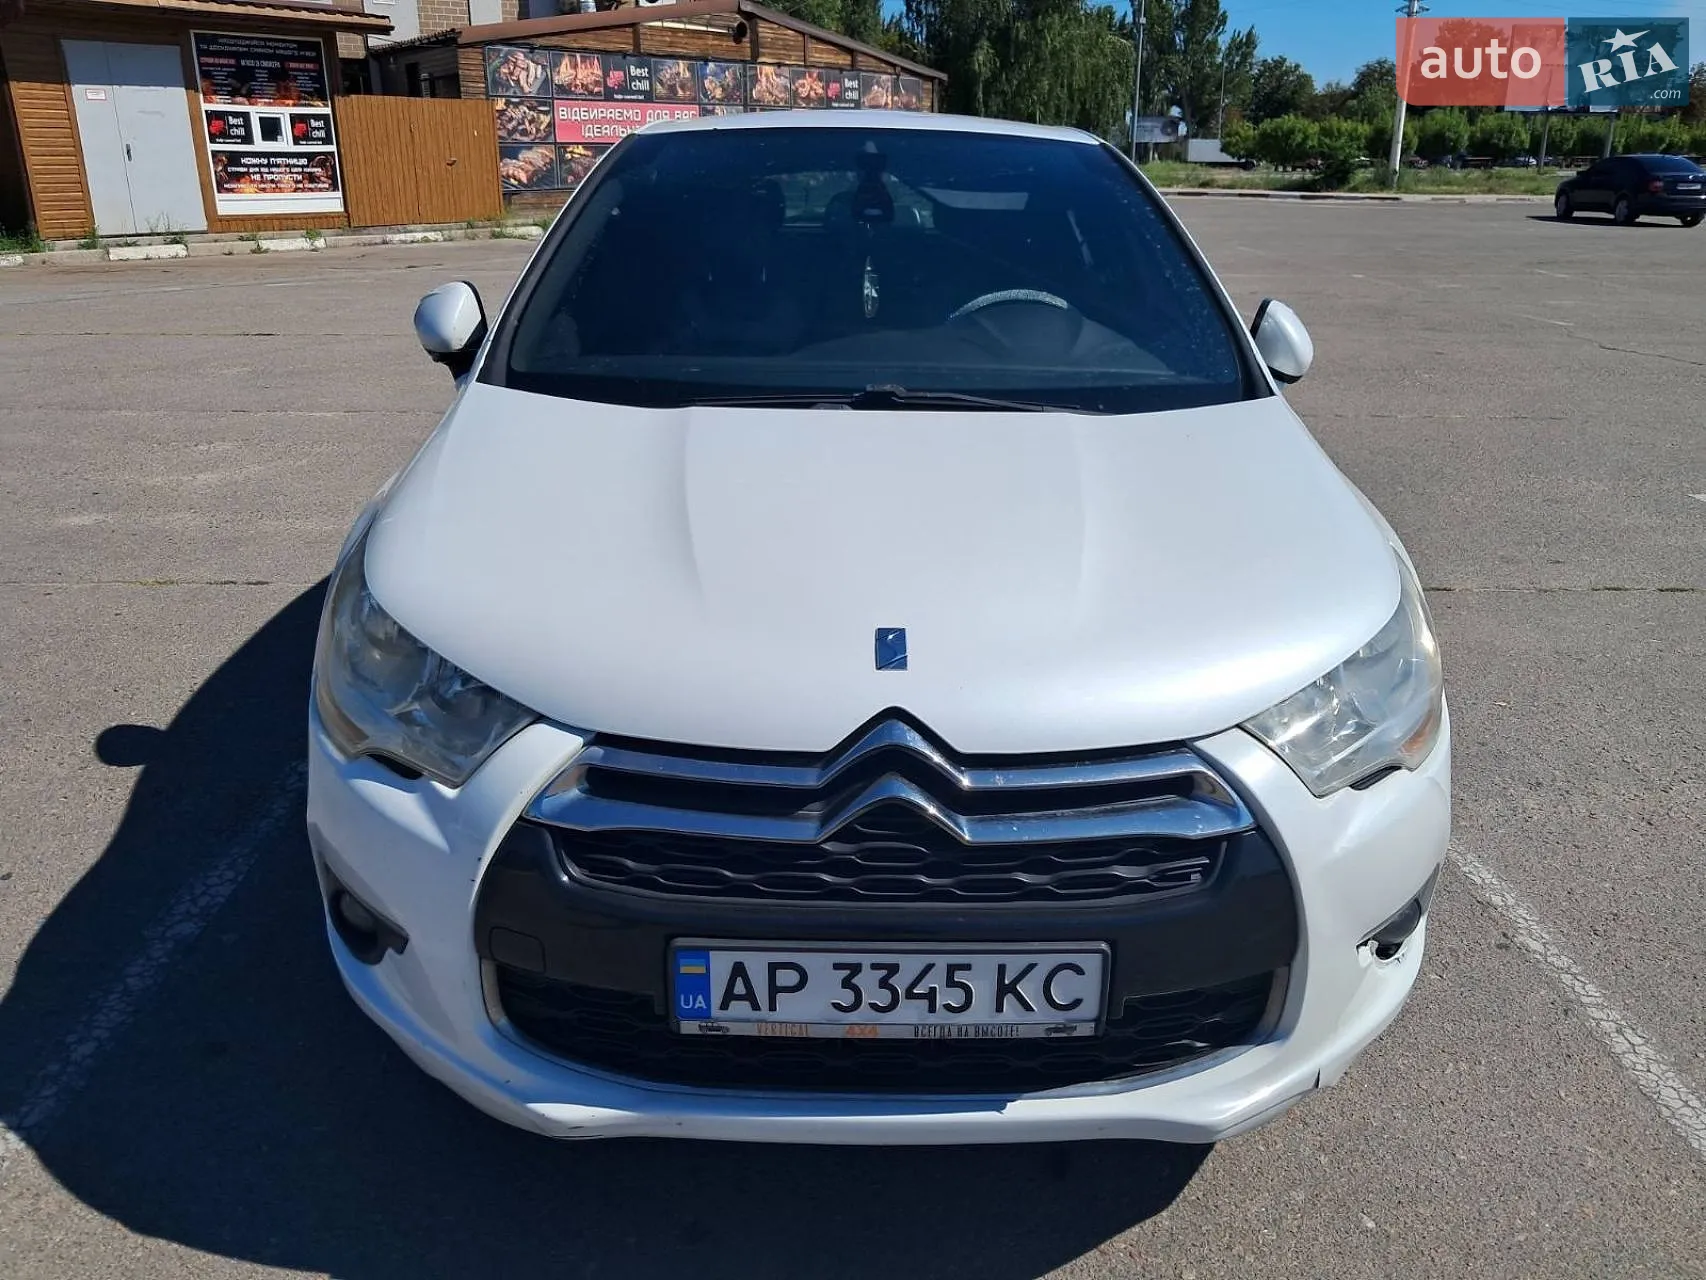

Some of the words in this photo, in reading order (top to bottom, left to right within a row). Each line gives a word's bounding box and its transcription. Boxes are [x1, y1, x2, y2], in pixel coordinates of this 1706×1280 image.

[630, 65, 649, 77] Best
[631, 78, 650, 91] chill
[844, 77, 859, 89] Best
[845, 89, 859, 100] chill
[559, 106, 642, 121] ВІДБИРАЄМО
[228, 115, 244, 125] Best
[310, 119, 325, 128] Best
[230, 127, 245, 136] chill
[311, 129, 326, 138] chill
[240, 157, 268, 165] КОЖНУ
[680, 994, 707, 1009] UA
[719, 961, 809, 1012] AP
[831, 962, 974, 1013] 3345
[995, 962, 1086, 1013] KC
[957, 1024, 969, 1037] НА
